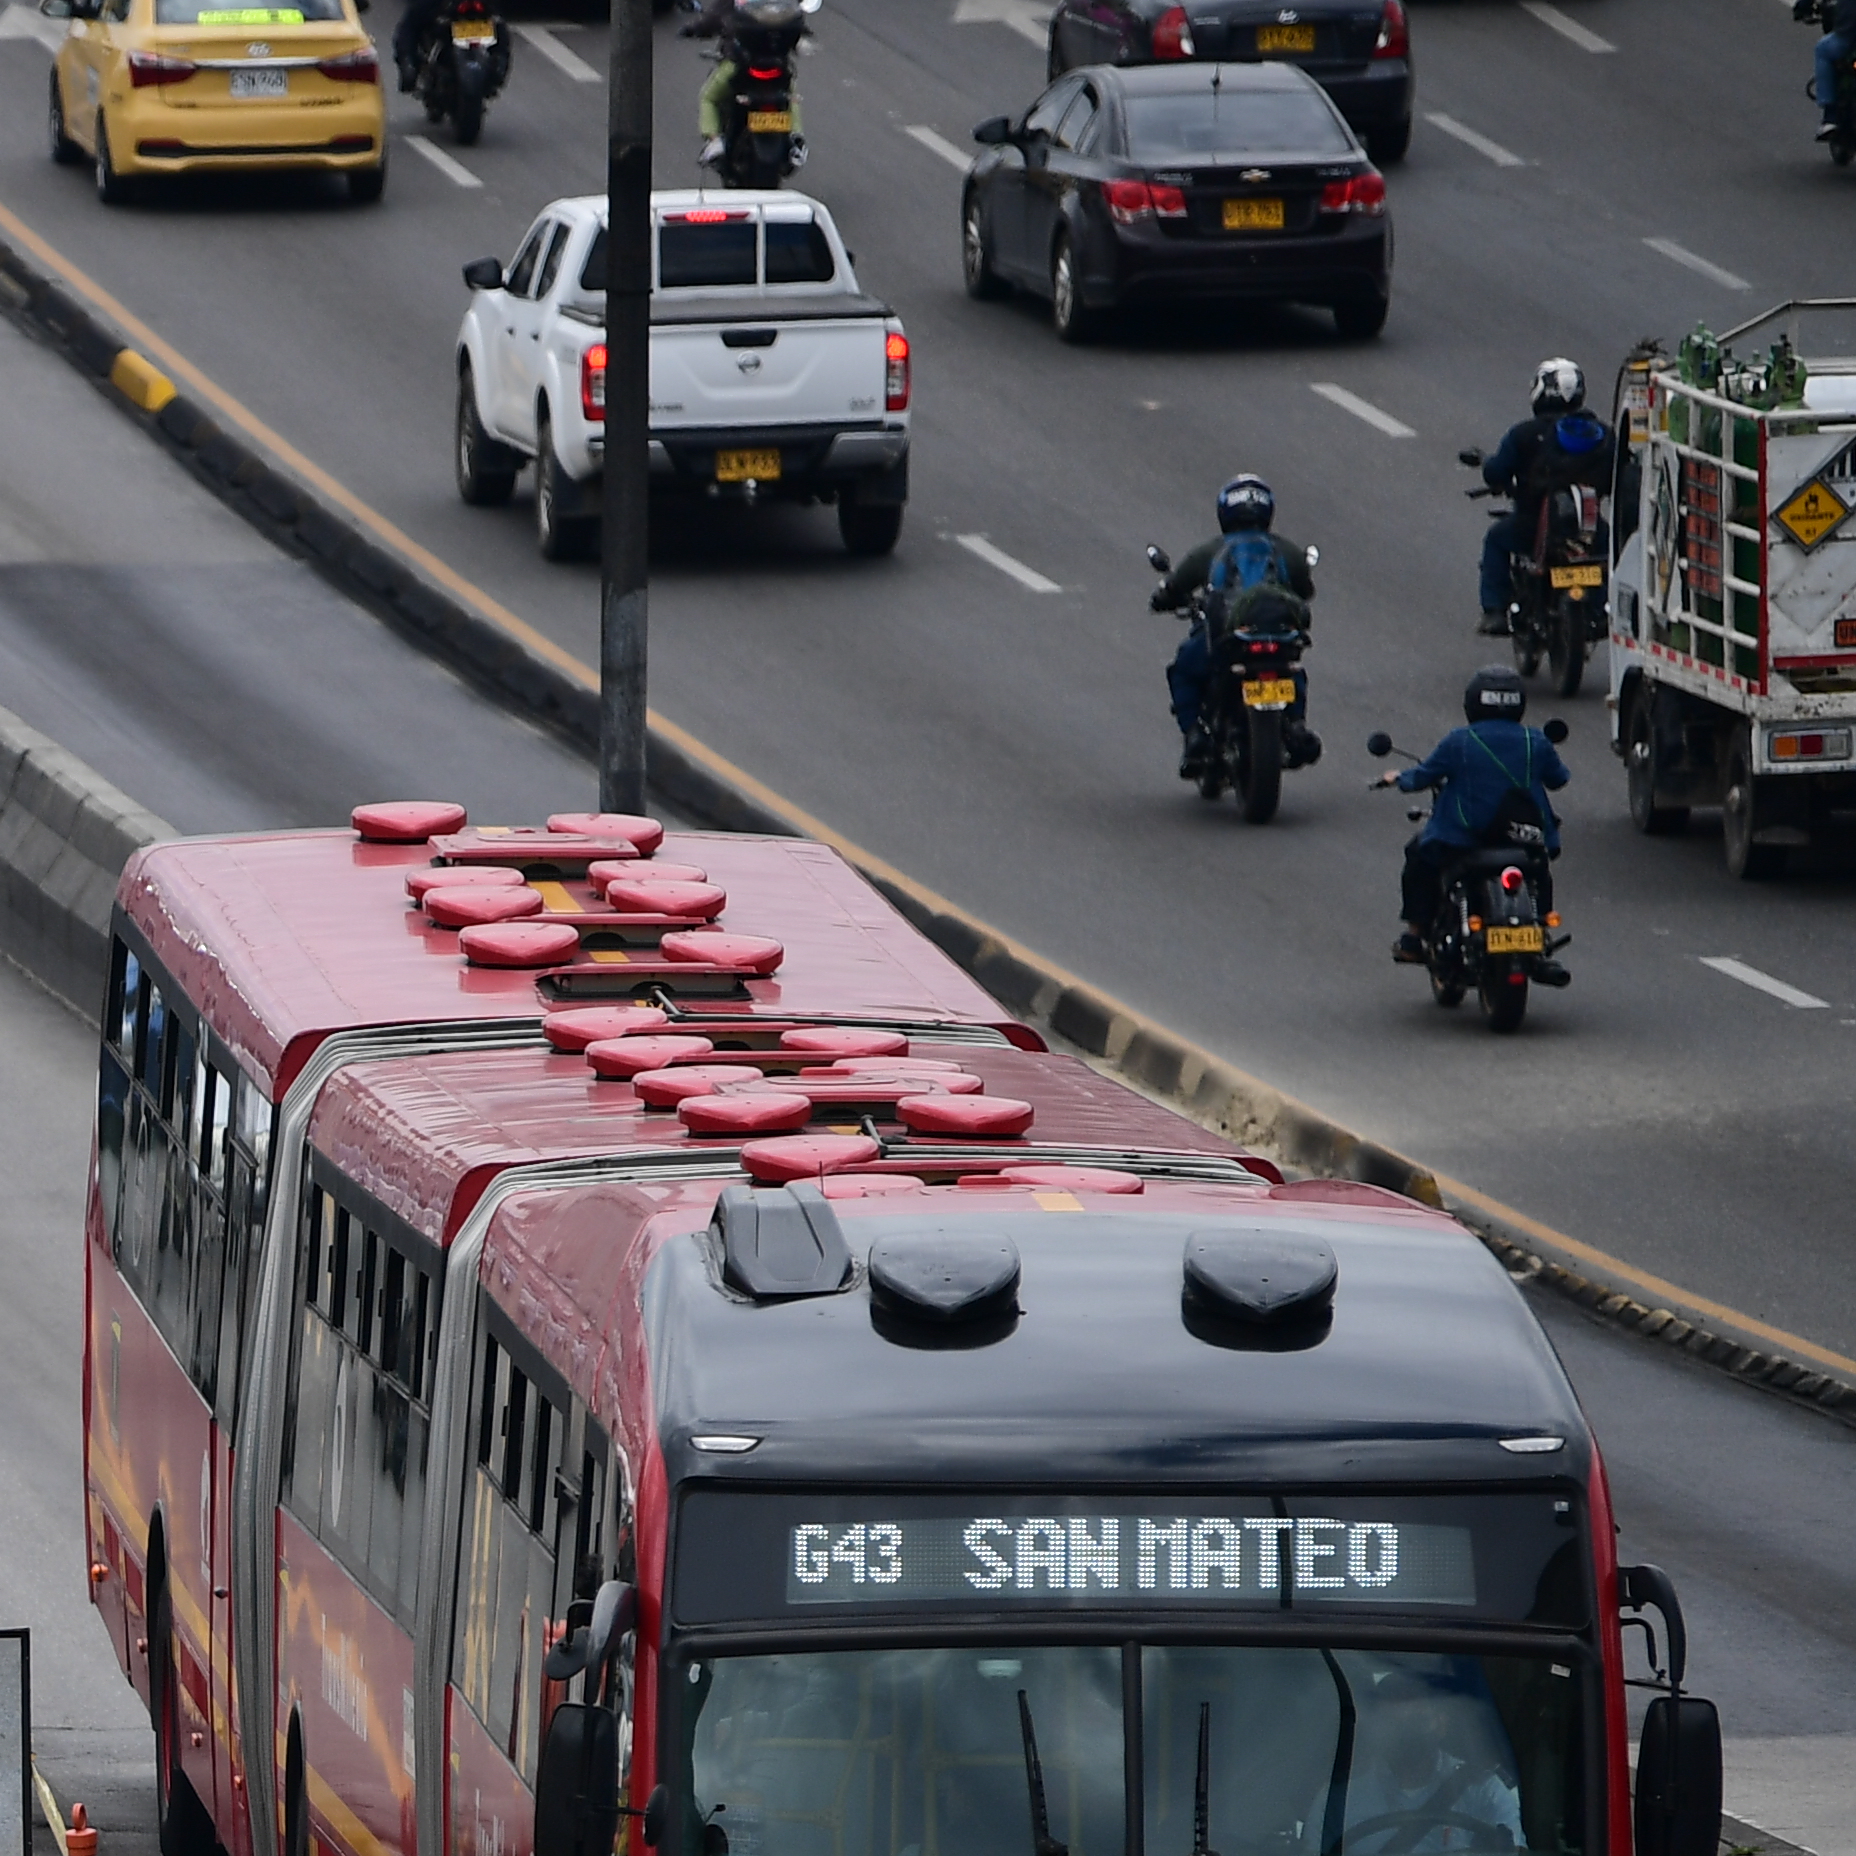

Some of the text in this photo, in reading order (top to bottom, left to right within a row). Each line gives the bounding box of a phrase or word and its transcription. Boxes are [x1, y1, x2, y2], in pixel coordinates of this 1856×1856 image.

[793, 1518, 1400, 1590] G43 SAN MATEO
